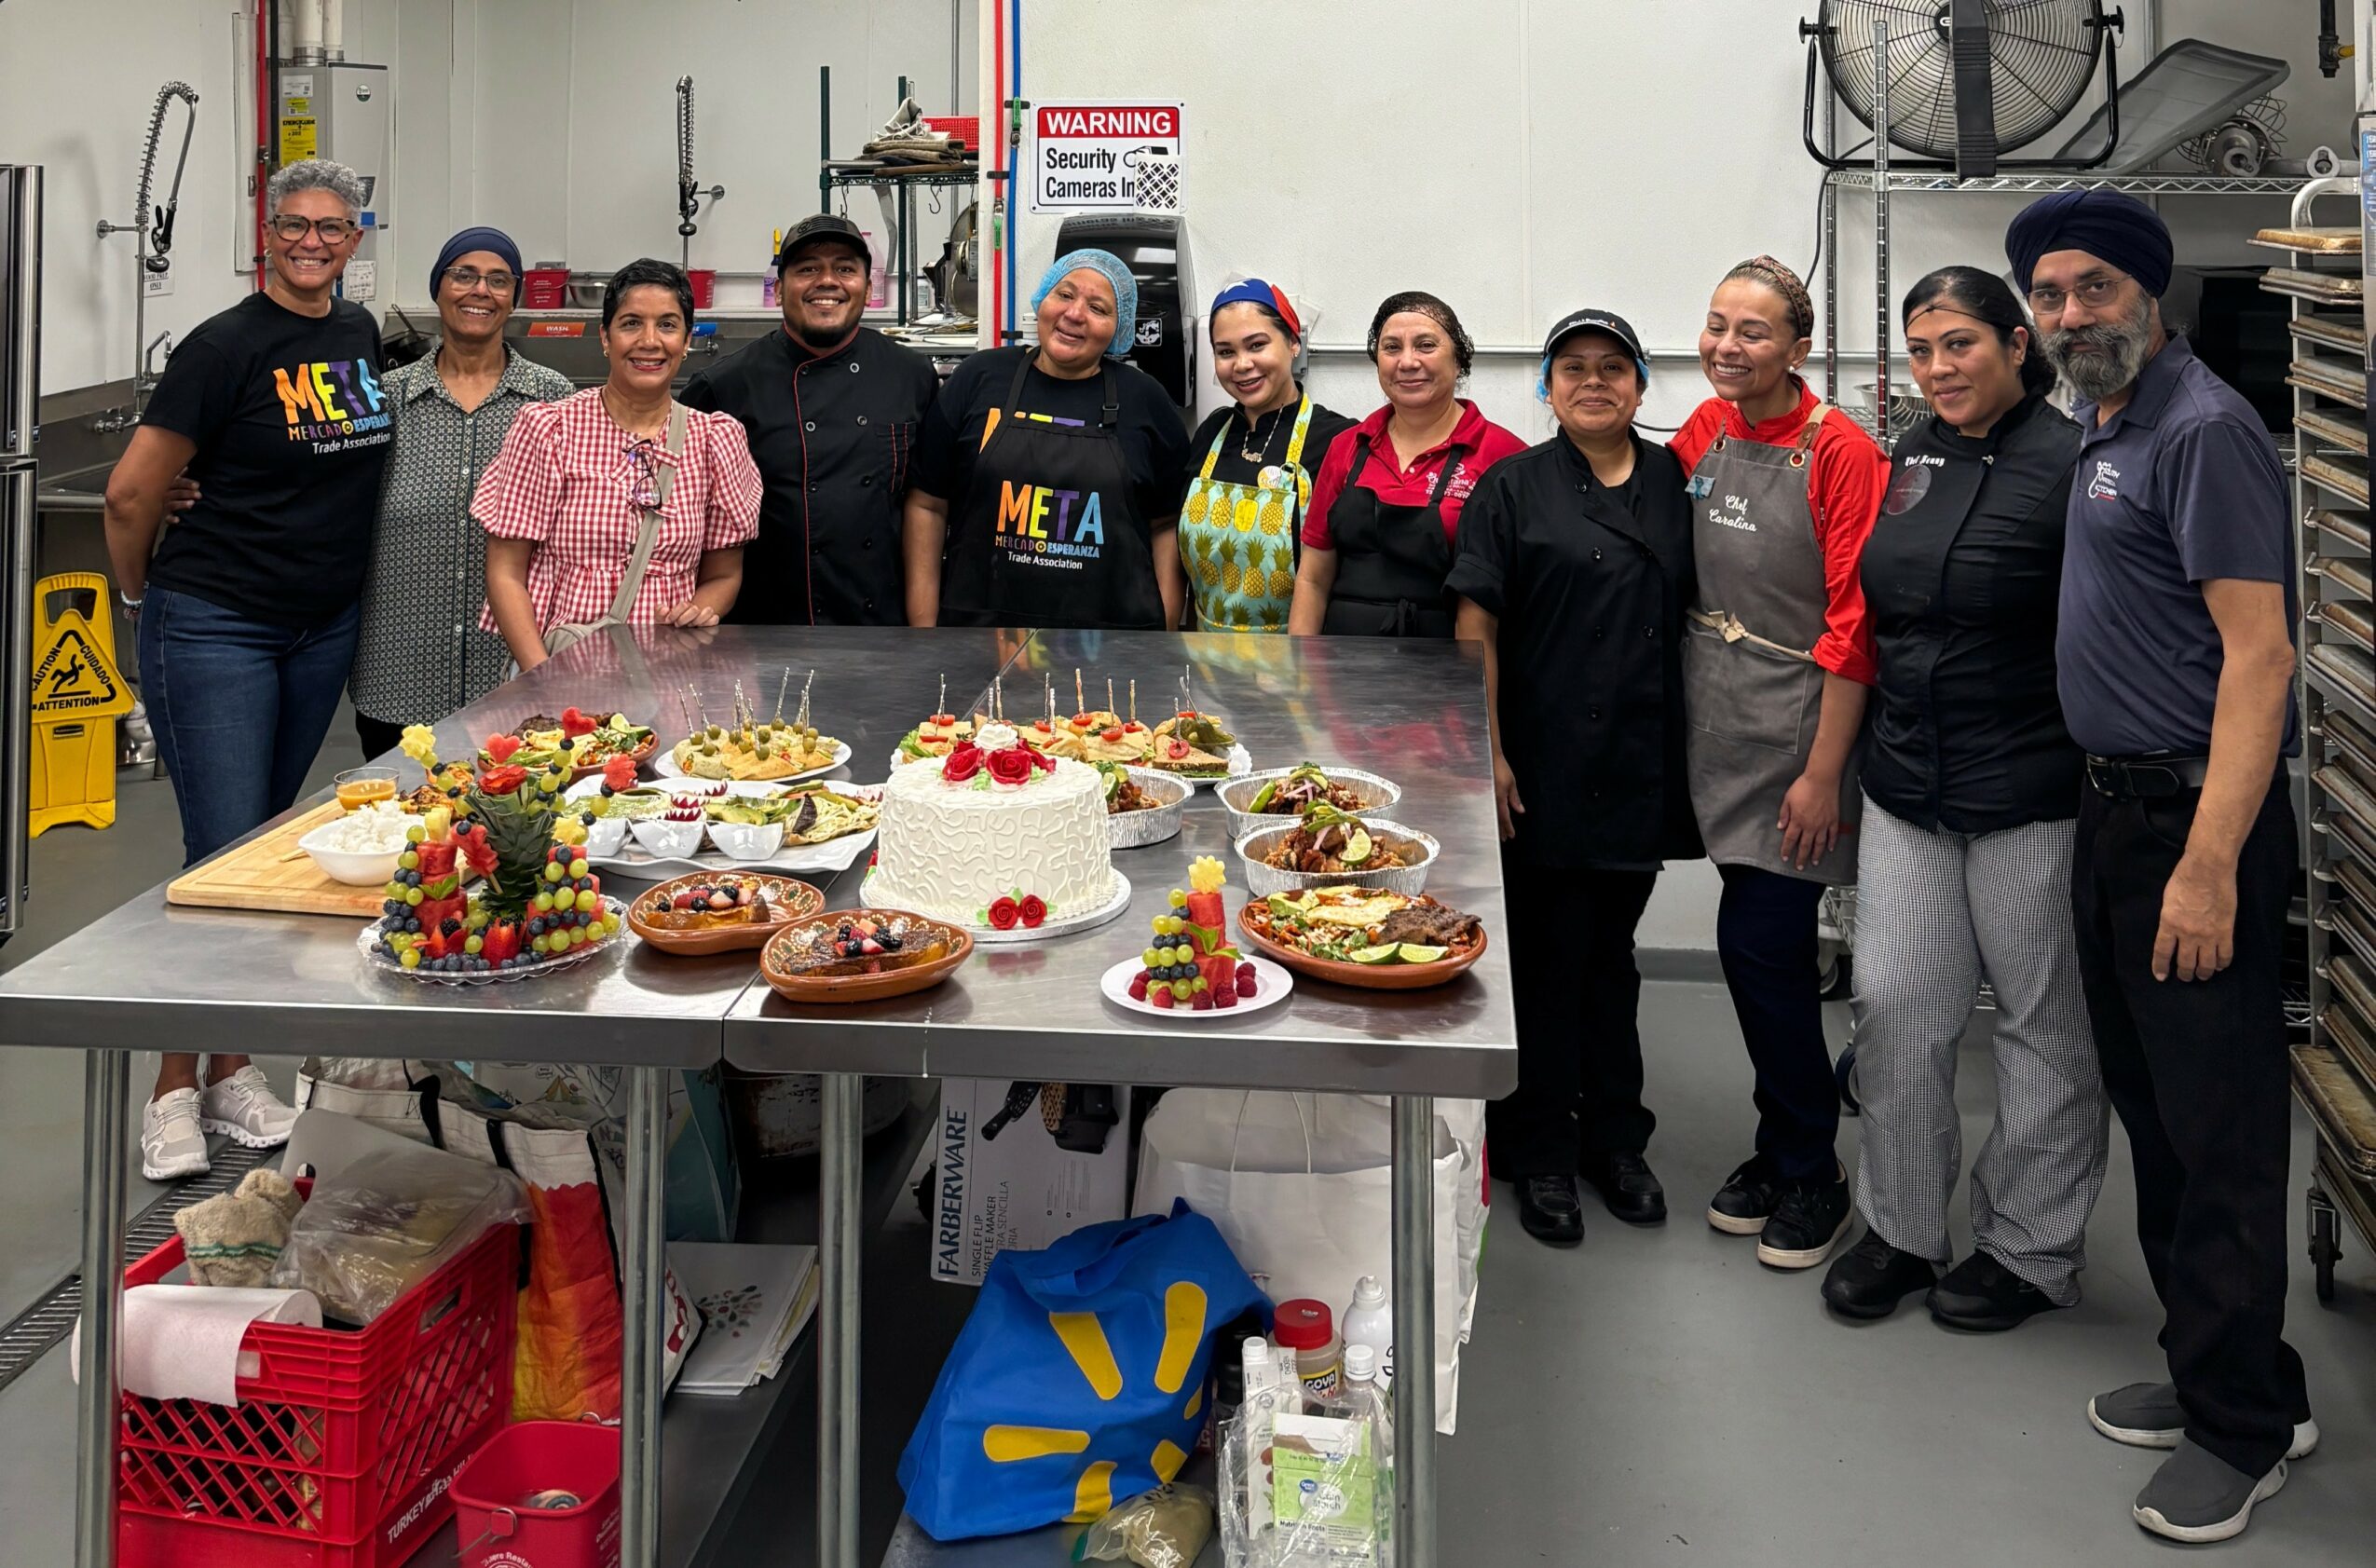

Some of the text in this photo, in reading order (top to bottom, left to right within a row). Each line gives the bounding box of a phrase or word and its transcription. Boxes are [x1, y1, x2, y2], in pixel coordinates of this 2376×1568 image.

[1045, 112, 1171, 134] WARNING
[1045, 147, 1116, 173] Security
[1045, 176, 1116, 198] Cameras
[273, 358, 387, 425] META
[312, 432, 391, 455] Trade Association
[997, 480, 1104, 544] META
[1725, 495, 1748, 515] Chef
[1709, 509, 1757, 532] Carolina
[1008, 551, 1083, 569] Trade Association
[1046, 541, 1100, 558] ESPERANZA
[80, 644, 110, 685] CUIDADO
[37, 696, 100, 711] ATTENTION
[937, 1110, 967, 1276] FARBERWARE
[997, 1180, 1009, 1229] SENCILLA
[986, 1195, 997, 1234] MAKER
[971, 1214, 984, 1277] SINGLE FLIP
[1305, 1372, 1335, 1389] GOYA
[388, 1496, 426, 1544] TURKEY
